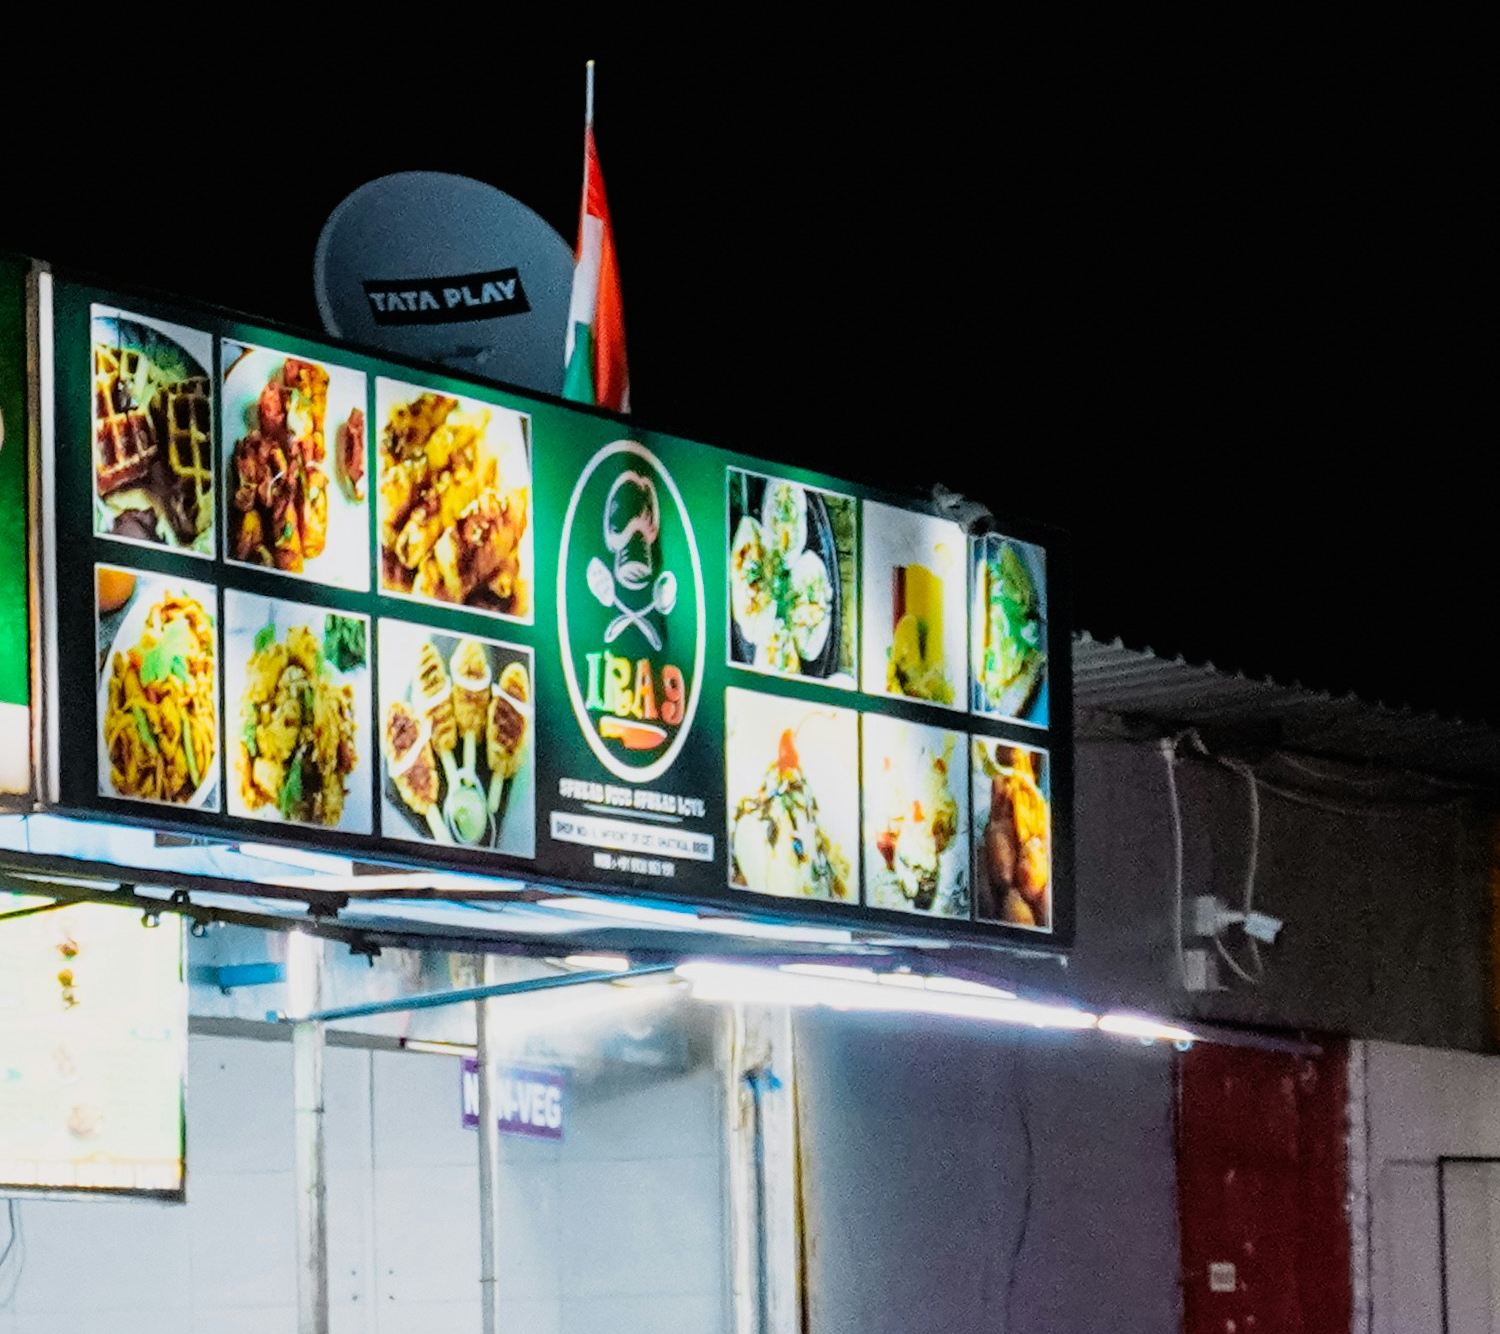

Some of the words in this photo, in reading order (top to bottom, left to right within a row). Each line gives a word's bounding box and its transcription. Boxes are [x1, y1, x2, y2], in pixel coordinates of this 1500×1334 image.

[368, 290, 440, 312] TATA
[443, 278, 517, 309] PLAY
[463, 1071, 563, 1129] NN-VEG
